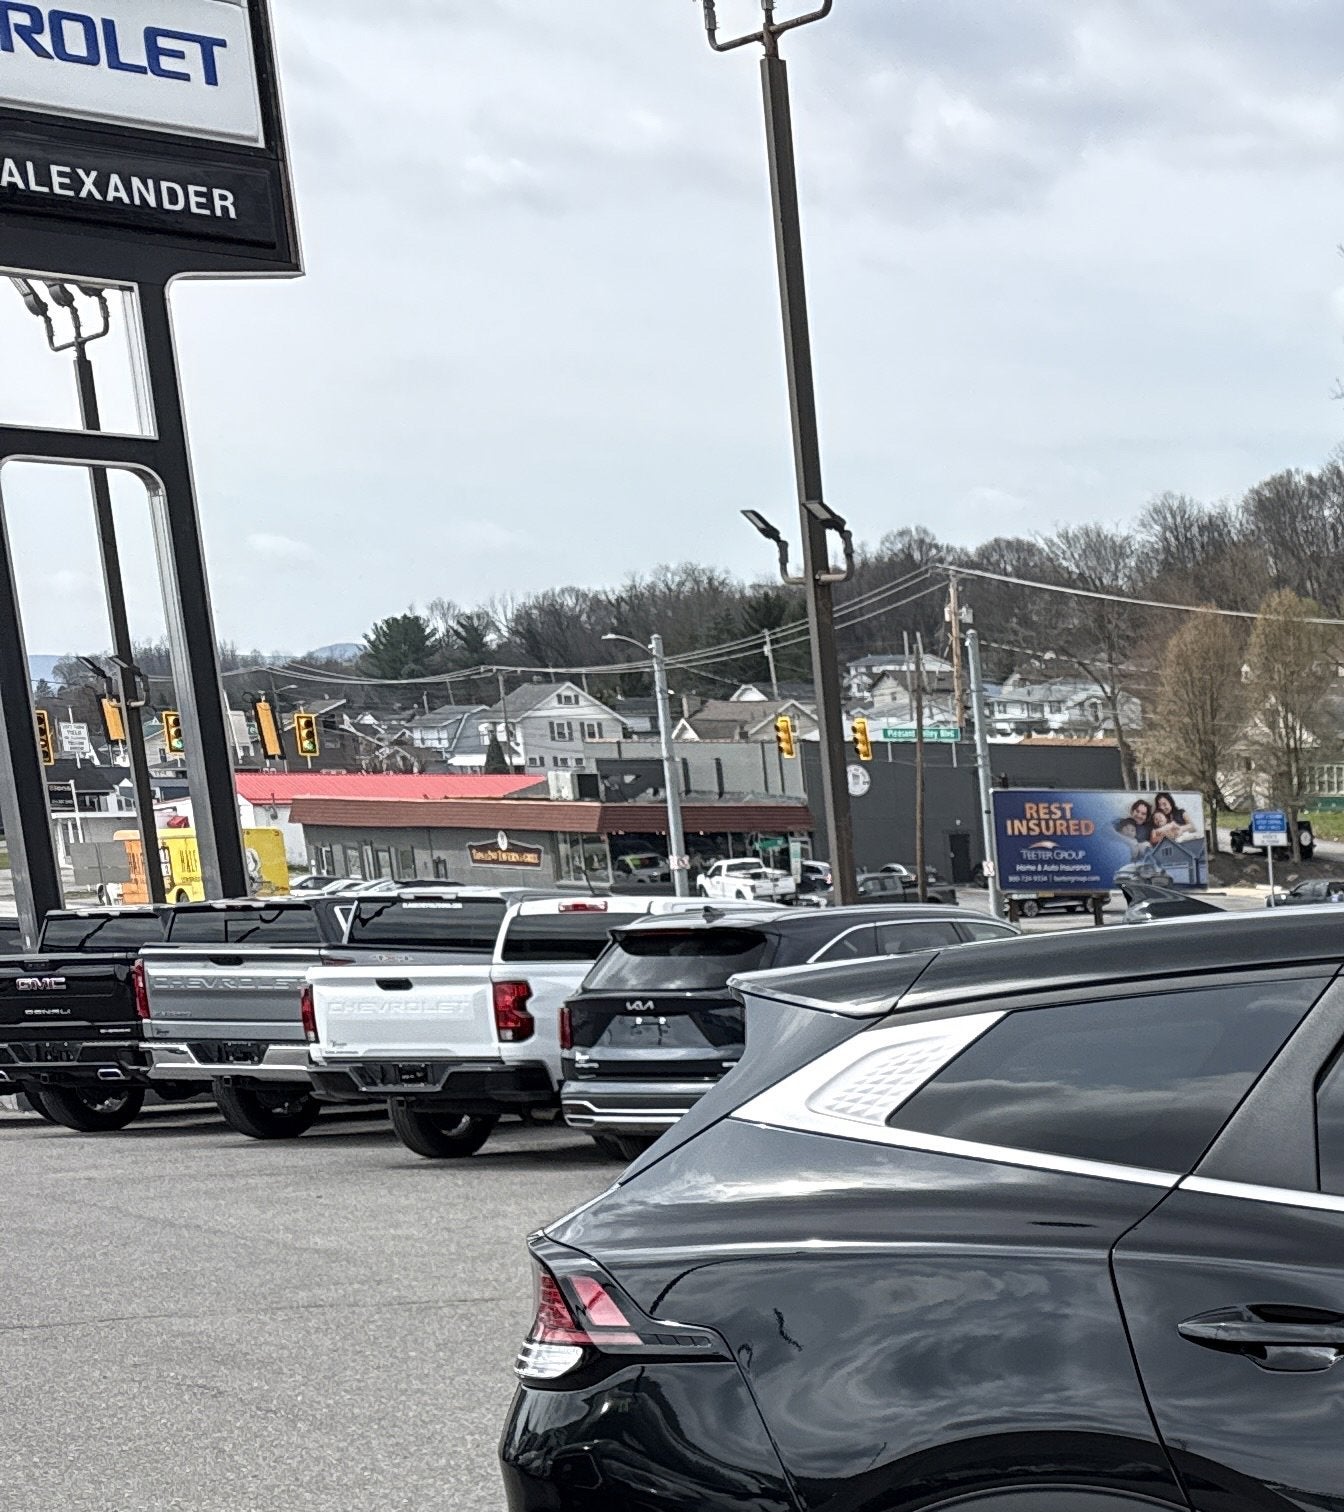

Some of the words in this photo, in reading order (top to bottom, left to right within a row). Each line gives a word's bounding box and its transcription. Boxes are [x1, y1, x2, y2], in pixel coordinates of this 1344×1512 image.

[1, 158, 237, 219] ALEXANDER
[887, 729, 915, 737] Pleasant
[1024, 802, 1073, 819] REST
[1006, 819, 1095, 836] INSURED
[1020, 849, 1053, 860] TEETER
[1053, 849, 1086, 860] GROUP
[16, 977, 67, 991] GMC
[153, 977, 311, 990] CHEVROLET
[327, 999, 471, 1015] CHEVROLET
